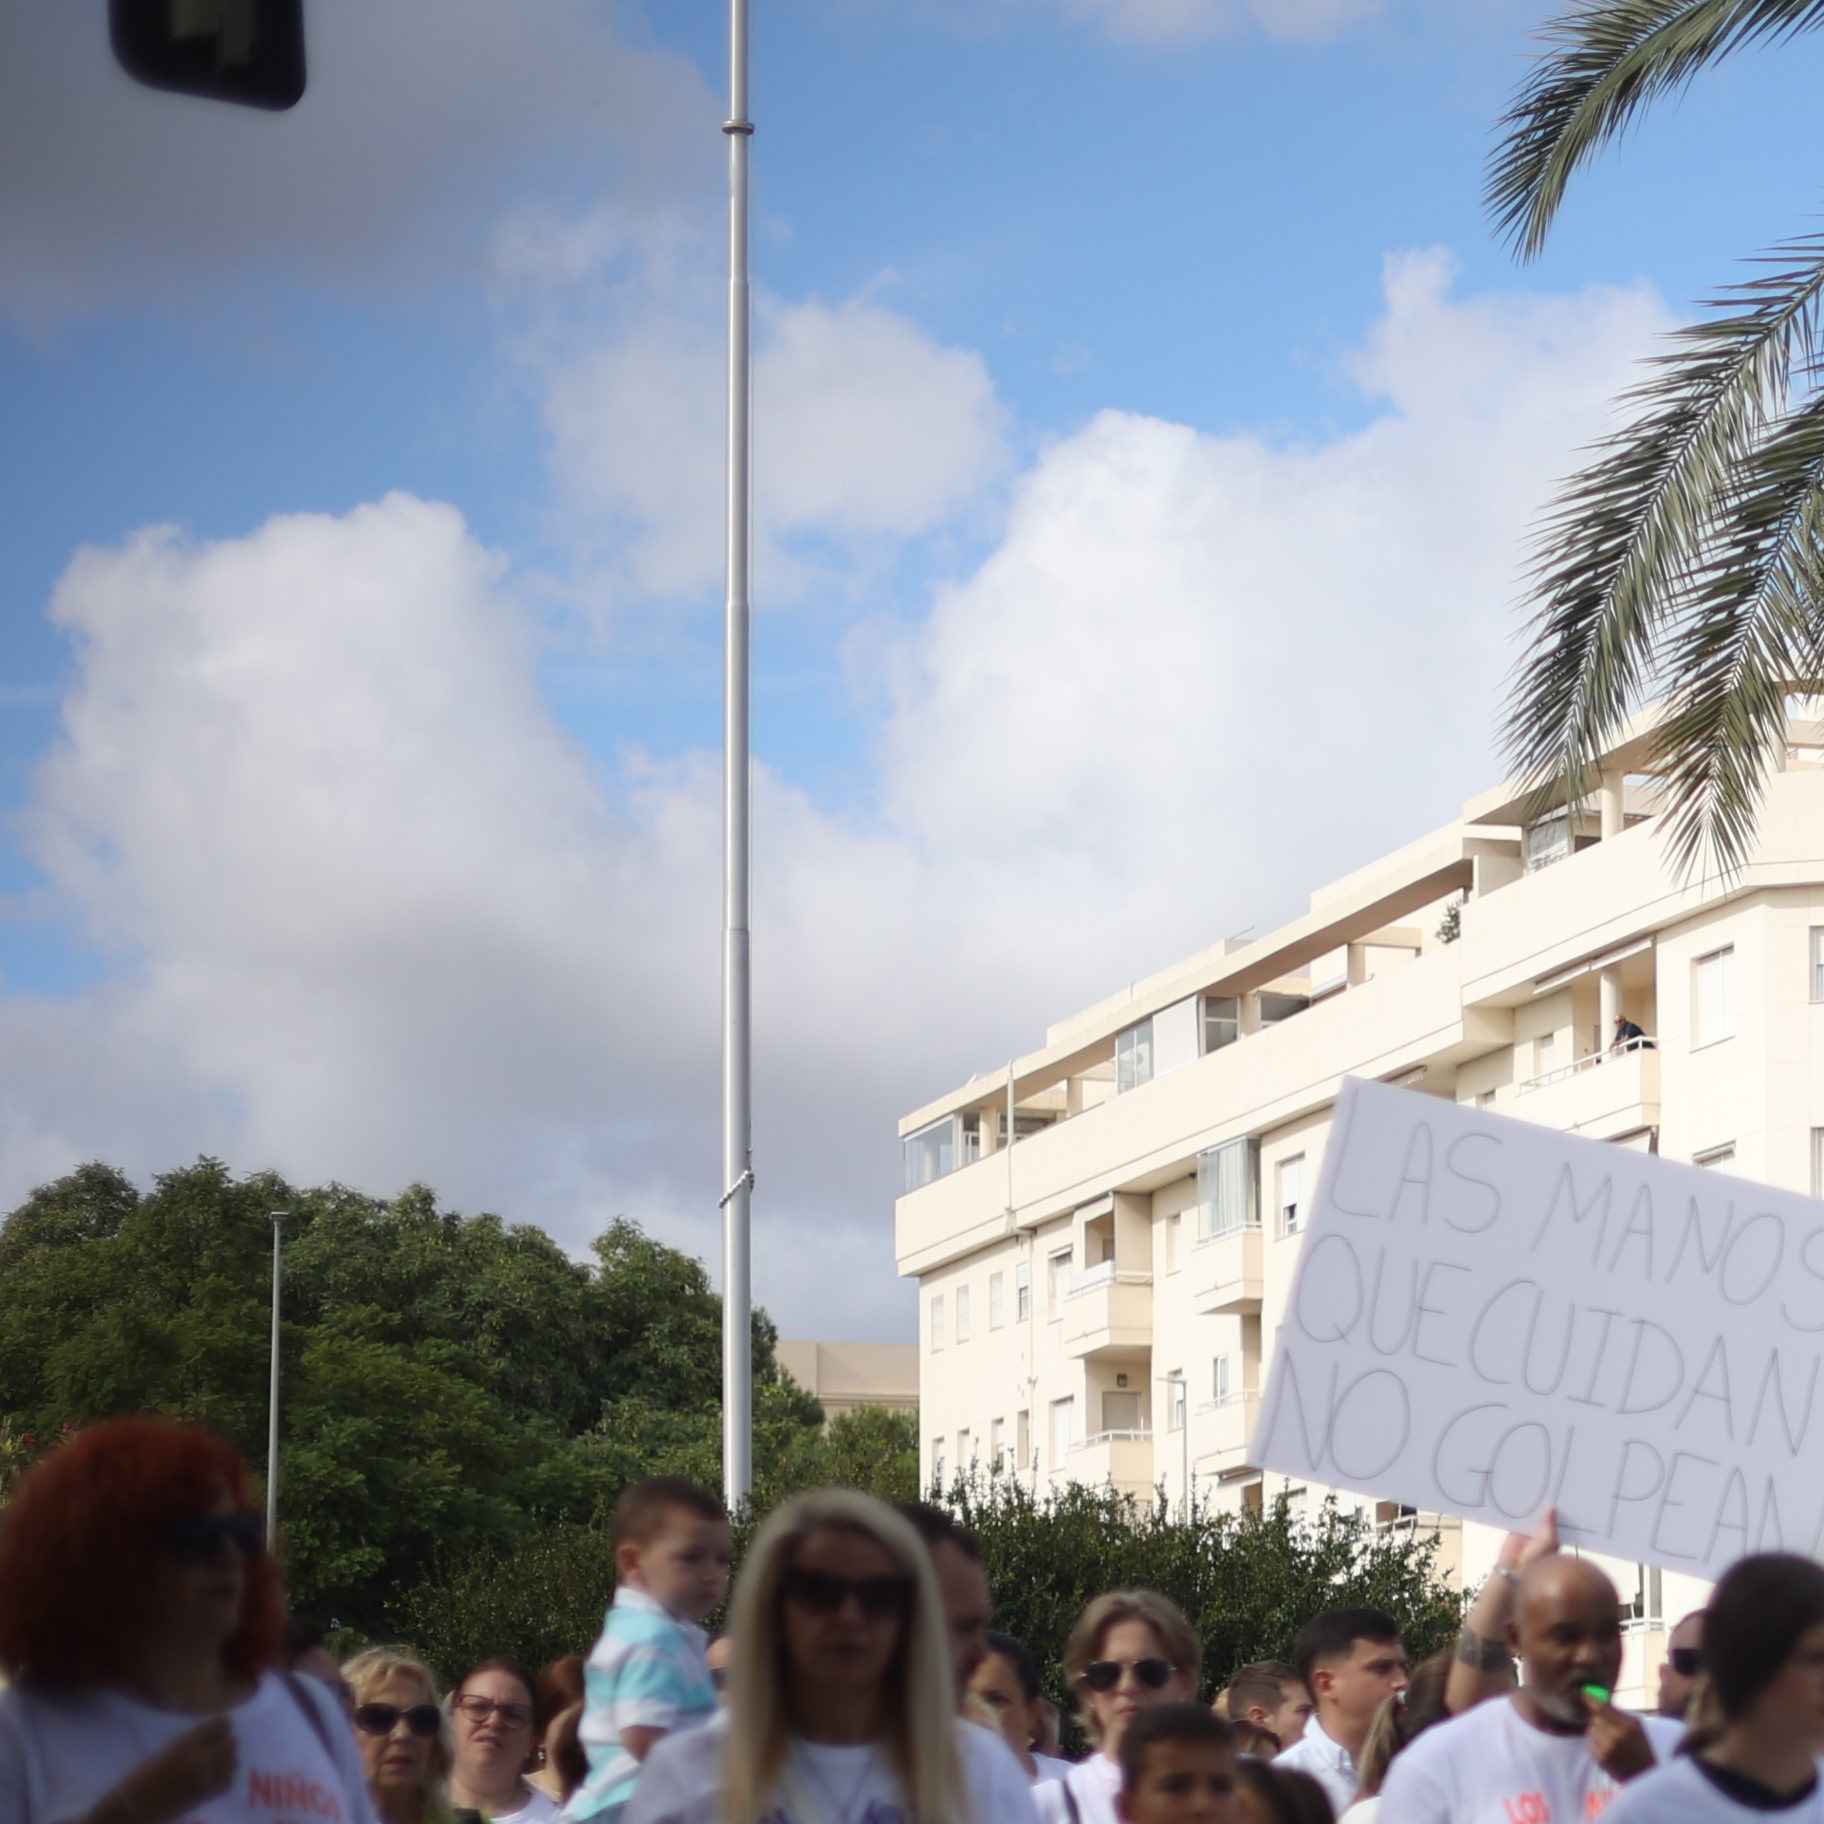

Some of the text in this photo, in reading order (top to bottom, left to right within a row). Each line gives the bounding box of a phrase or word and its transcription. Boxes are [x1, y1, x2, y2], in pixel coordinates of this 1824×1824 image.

[1329, 1088, 1503, 1234] LAS
[1259, 1347, 1413, 1481] NO
[1299, 1232, 1823, 1458] QUE CUIDAN
